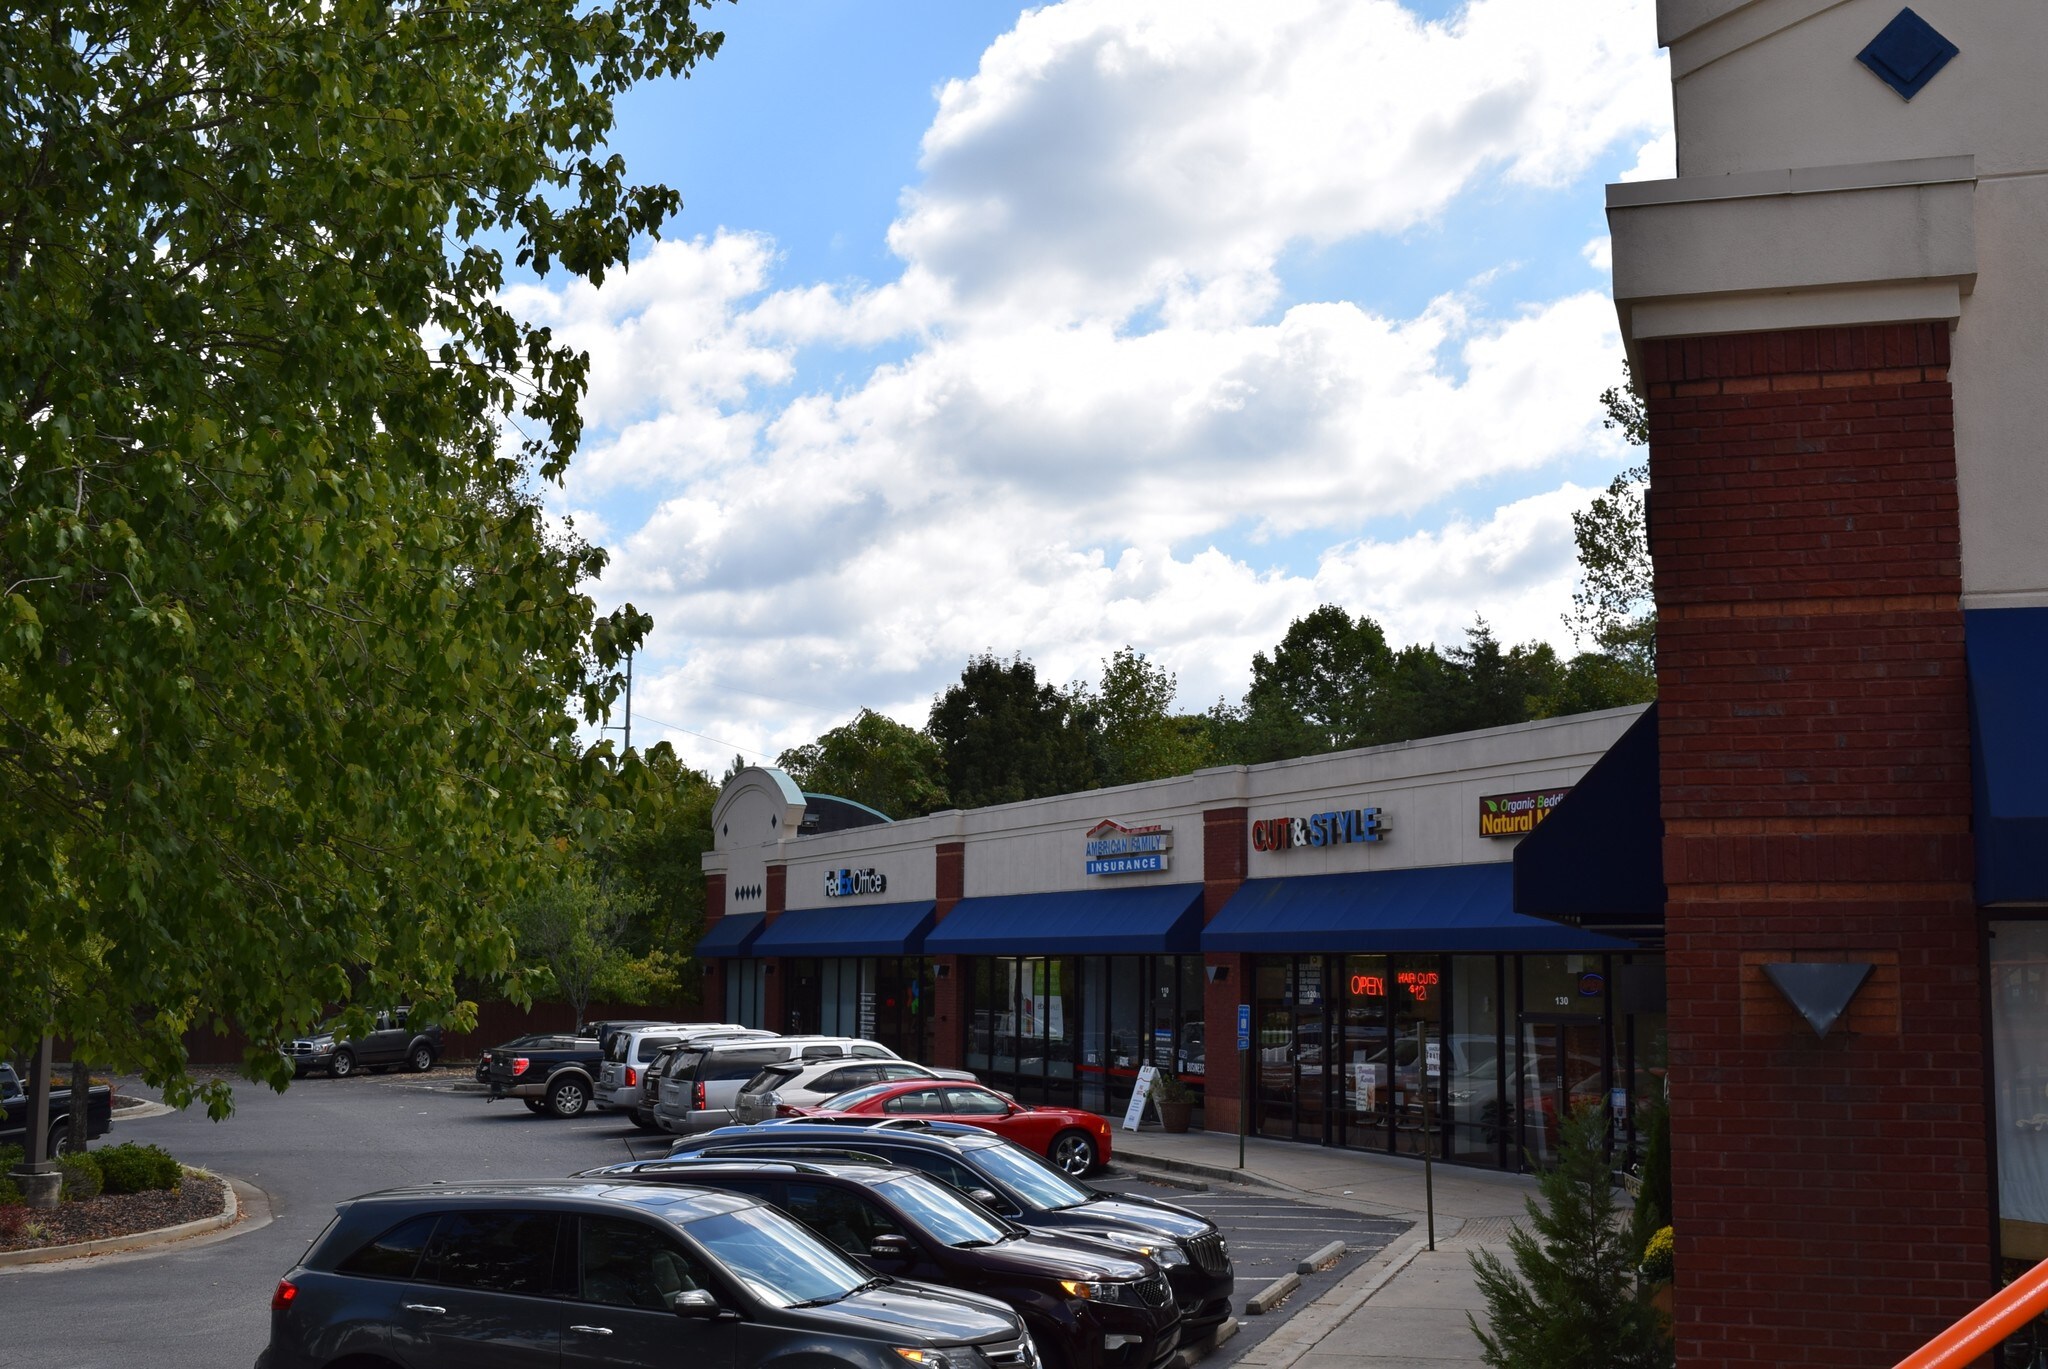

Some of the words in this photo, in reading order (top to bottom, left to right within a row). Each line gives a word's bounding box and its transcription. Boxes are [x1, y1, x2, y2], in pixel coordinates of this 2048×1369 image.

[1501, 797, 1535, 813] Organic
[1482, 810, 1533, 834] Natural
[1086, 839, 1128, 857] AMERICAN
[1131, 834, 1161, 852] FAMILY
[1091, 858, 1156, 873] INSURANCE
[1351, 975, 1384, 996] OPEN
[1417, 972, 1439, 985] CUTS
[1306, 990, 1317, 998] 120
[1555, 996, 1569, 1006] 130
[1187, 1062, 1205, 1074] BUSINESS
[1626, 1178, 1641, 1196] OPE
